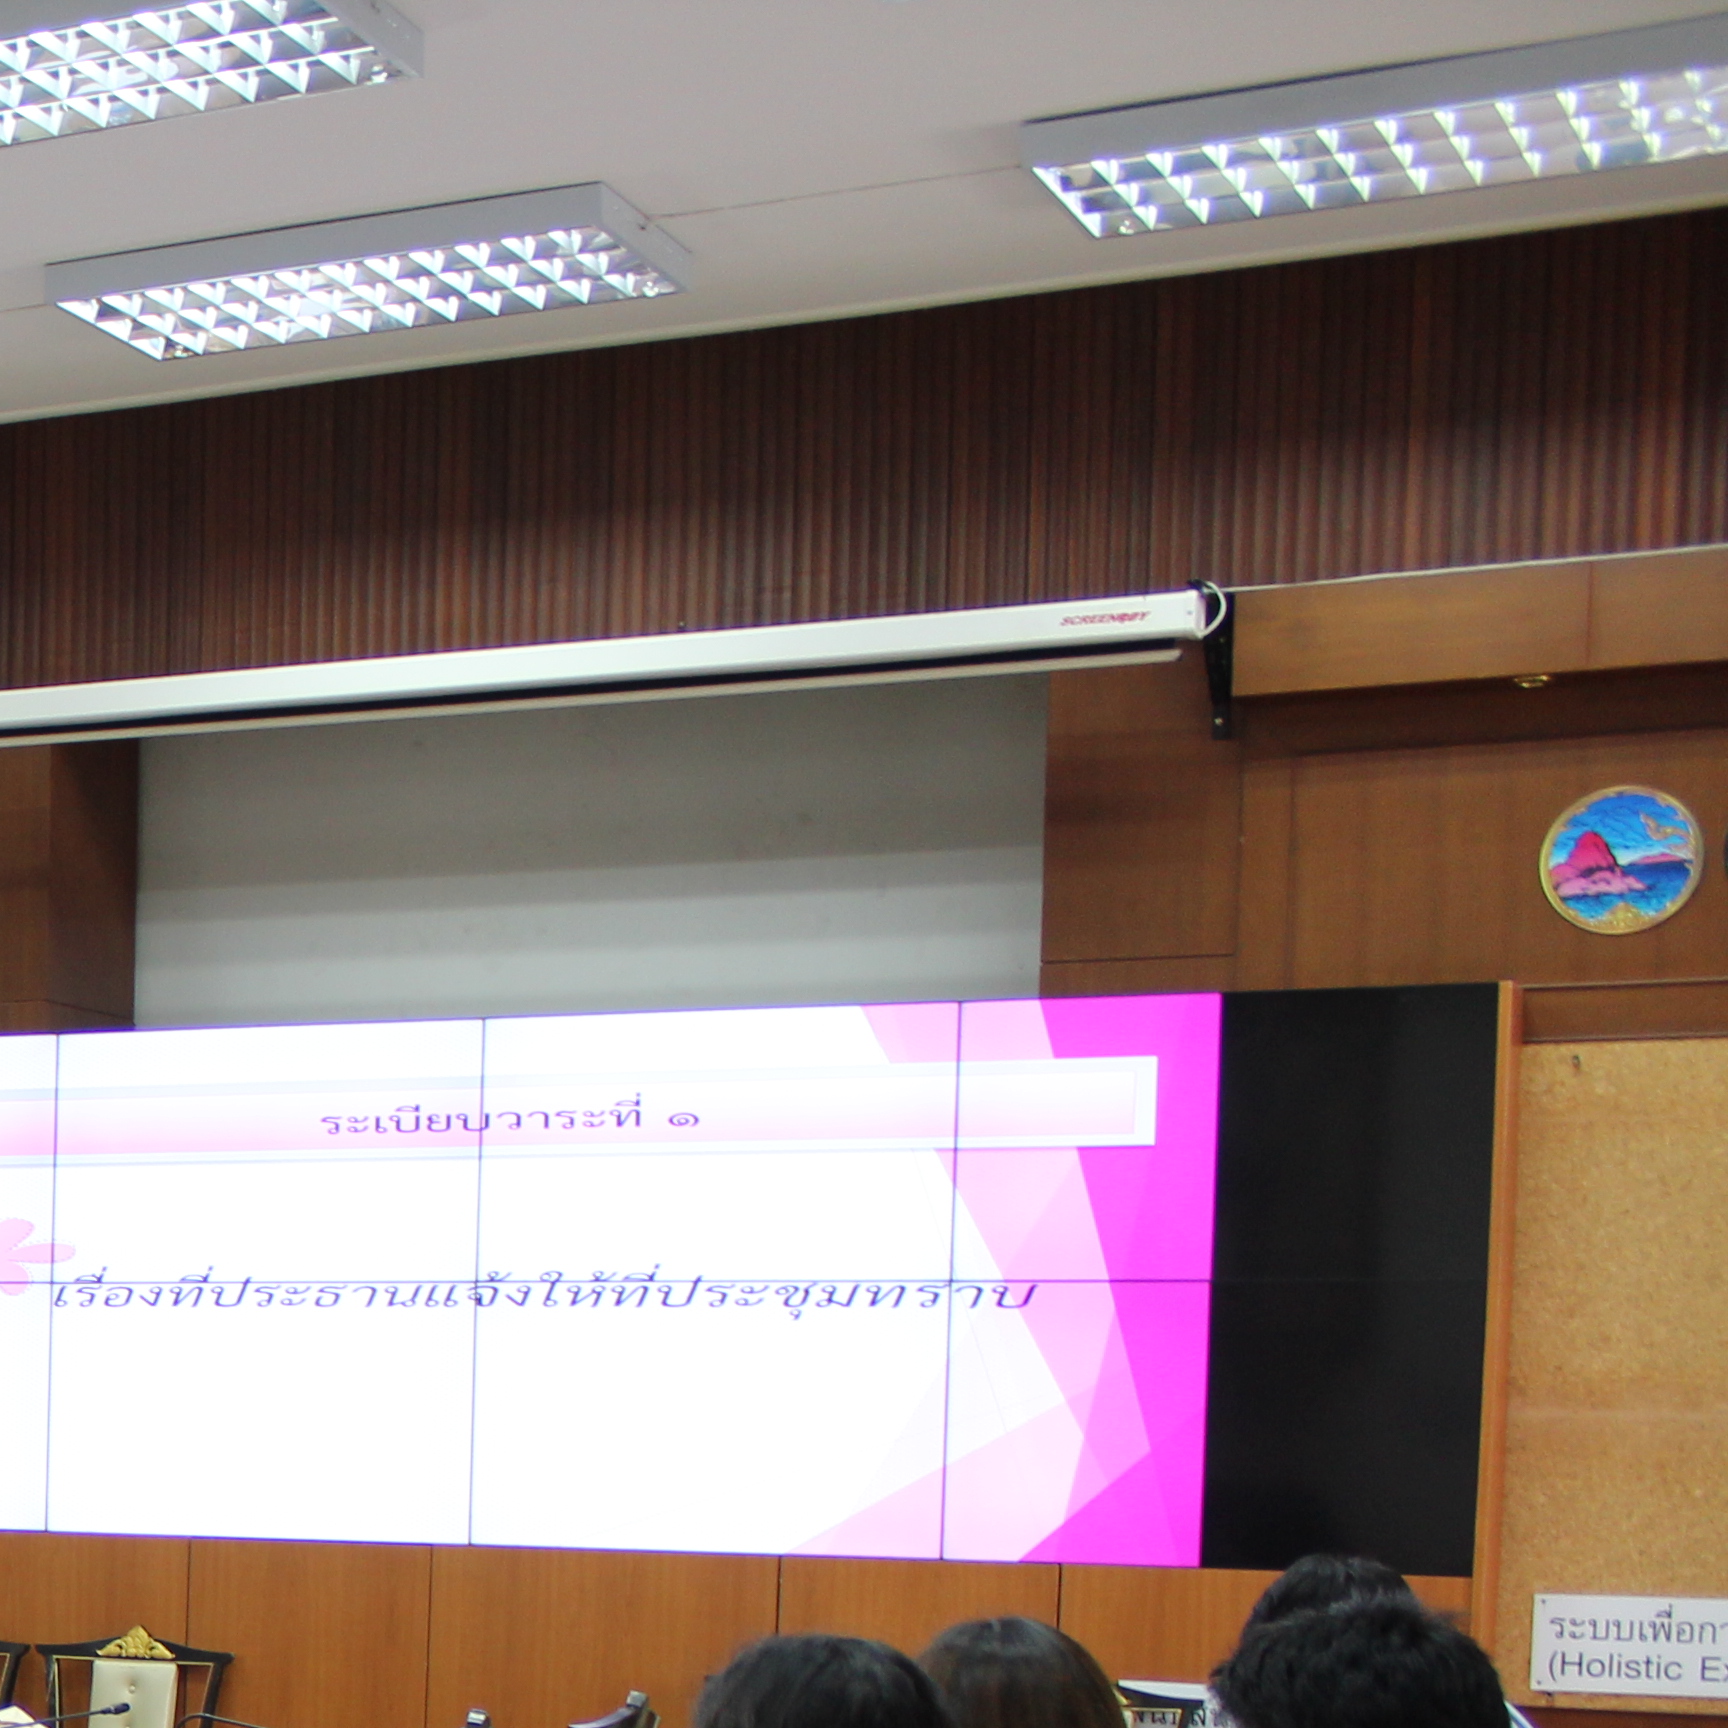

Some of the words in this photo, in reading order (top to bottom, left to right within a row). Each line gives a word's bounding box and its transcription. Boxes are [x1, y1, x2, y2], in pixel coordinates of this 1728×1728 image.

[321, 1092, 642, 1135] ระเบียบวาระที่
[667, 1111, 700, 1128] ๑
[53, 1264, 1039, 1320] เรื่องที่ประธานแจ้งให้ที่ประชุมทราบ
[1548, 1650, 1683, 1682] (Holistic
